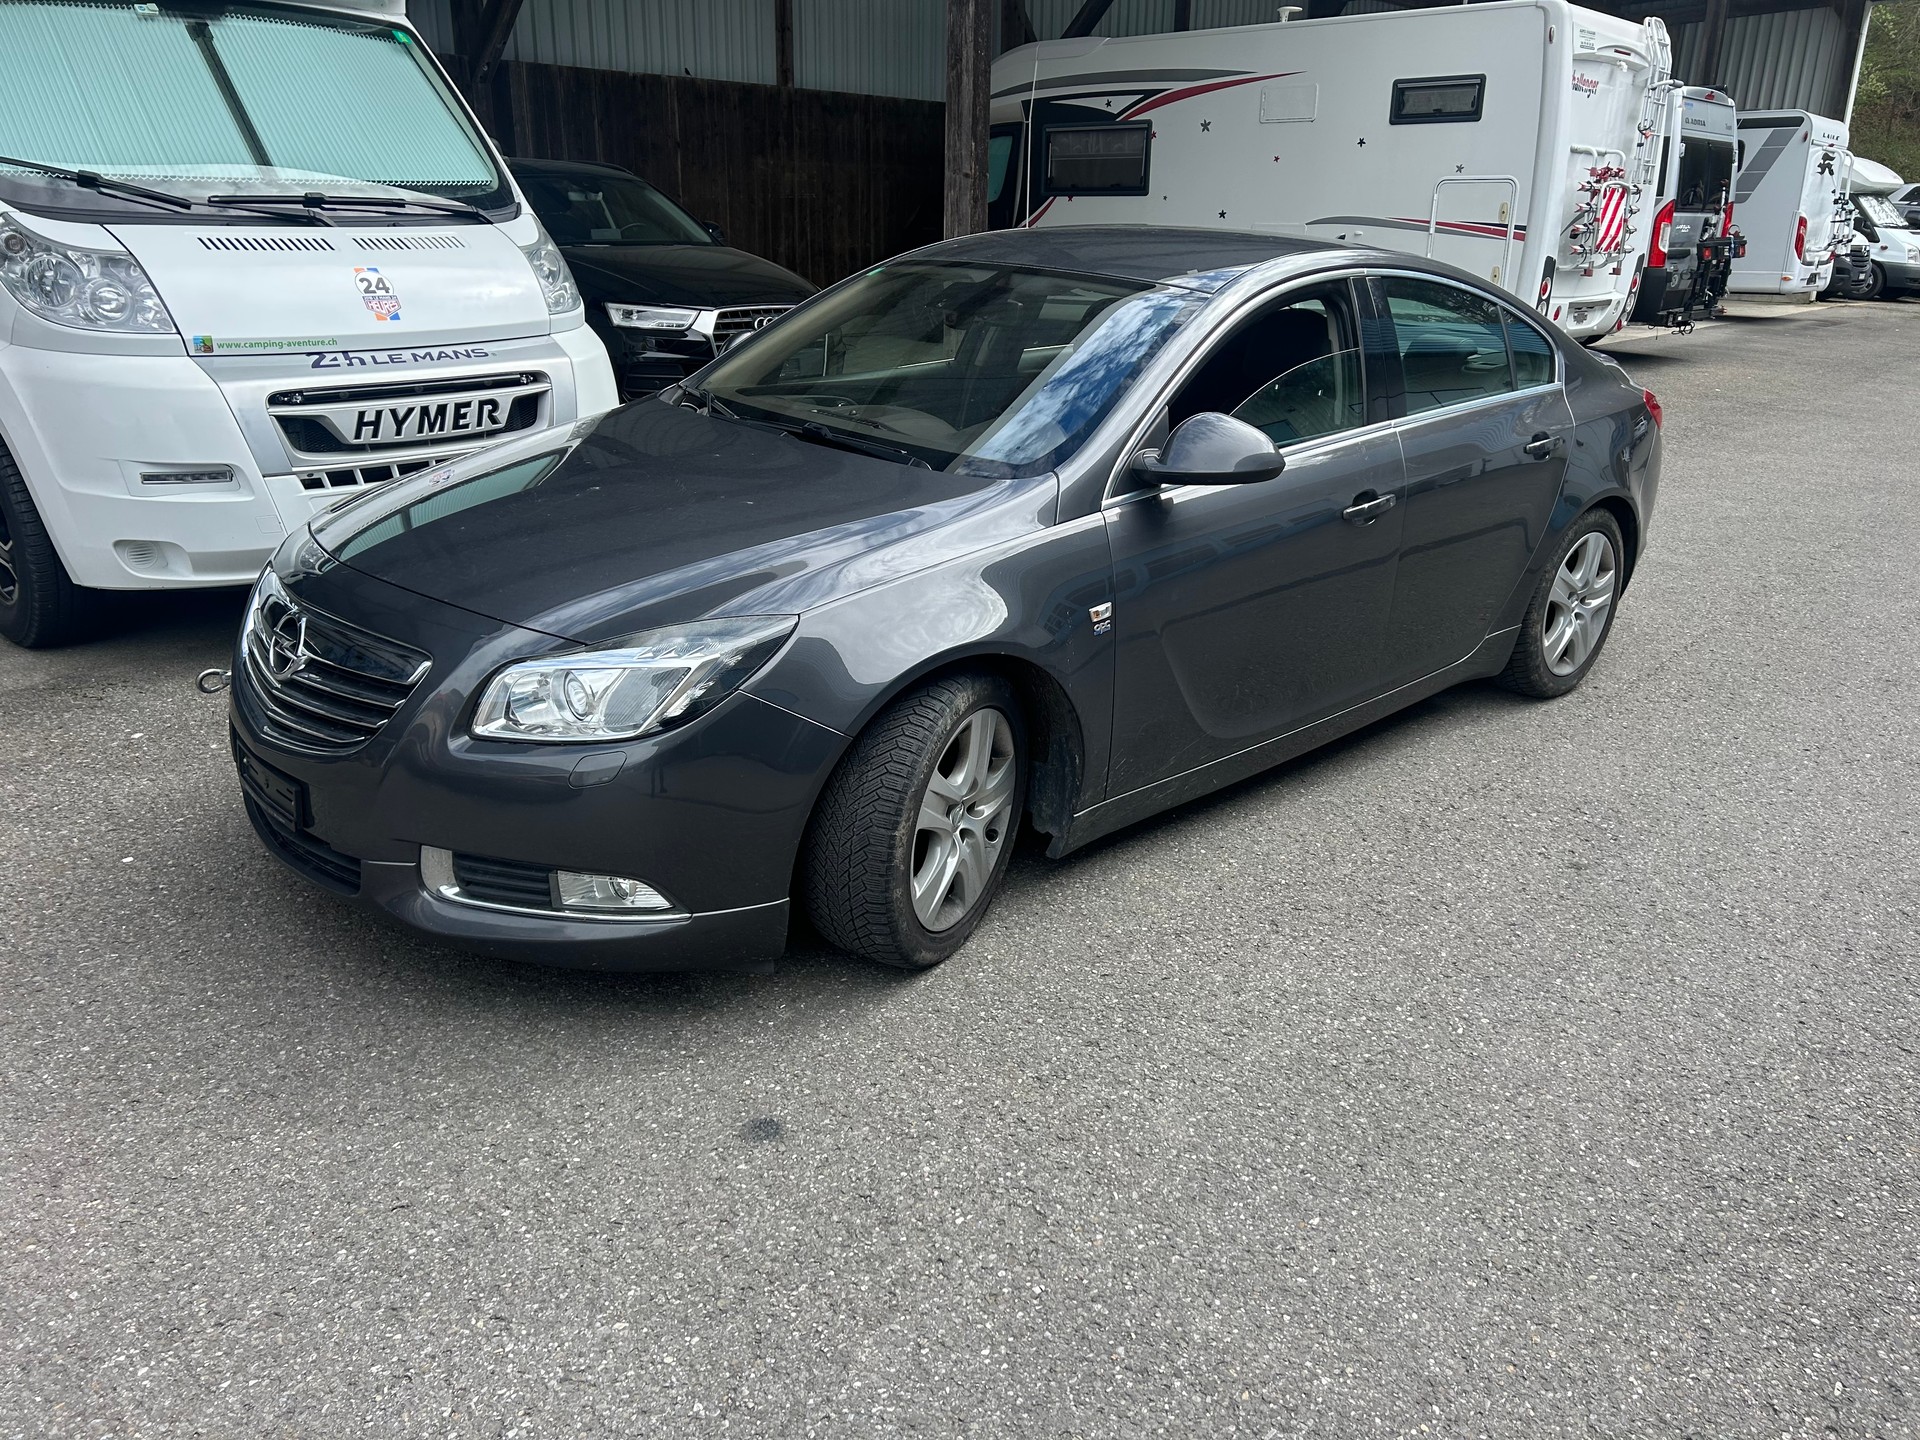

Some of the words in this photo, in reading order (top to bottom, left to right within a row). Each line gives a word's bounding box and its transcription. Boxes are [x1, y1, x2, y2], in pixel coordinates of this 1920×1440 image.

[358, 277, 391, 295] 24
[216, 337, 338, 350] www.camping-aventure.ch
[370, 353, 407, 365] LE
[411, 347, 490, 362] MANS
[353, 397, 505, 441] HYMER
